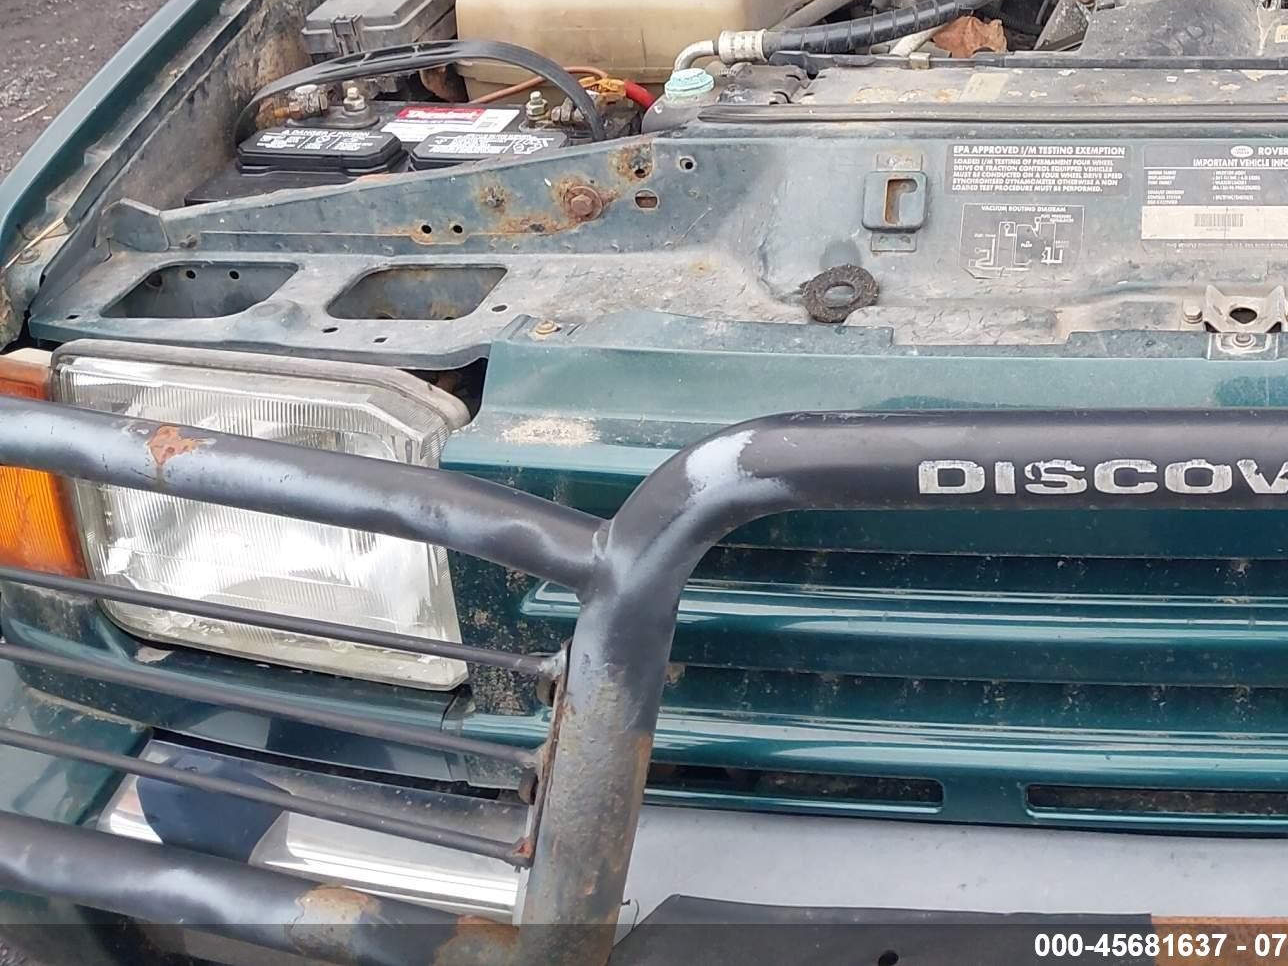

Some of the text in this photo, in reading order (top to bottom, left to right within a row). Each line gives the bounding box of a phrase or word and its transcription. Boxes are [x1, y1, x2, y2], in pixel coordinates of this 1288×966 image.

[954, 146, 1125, 155] EPA APPROVED I/M TESTING EXEMPTION
[1258, 147, 1288, 155] ROVER
